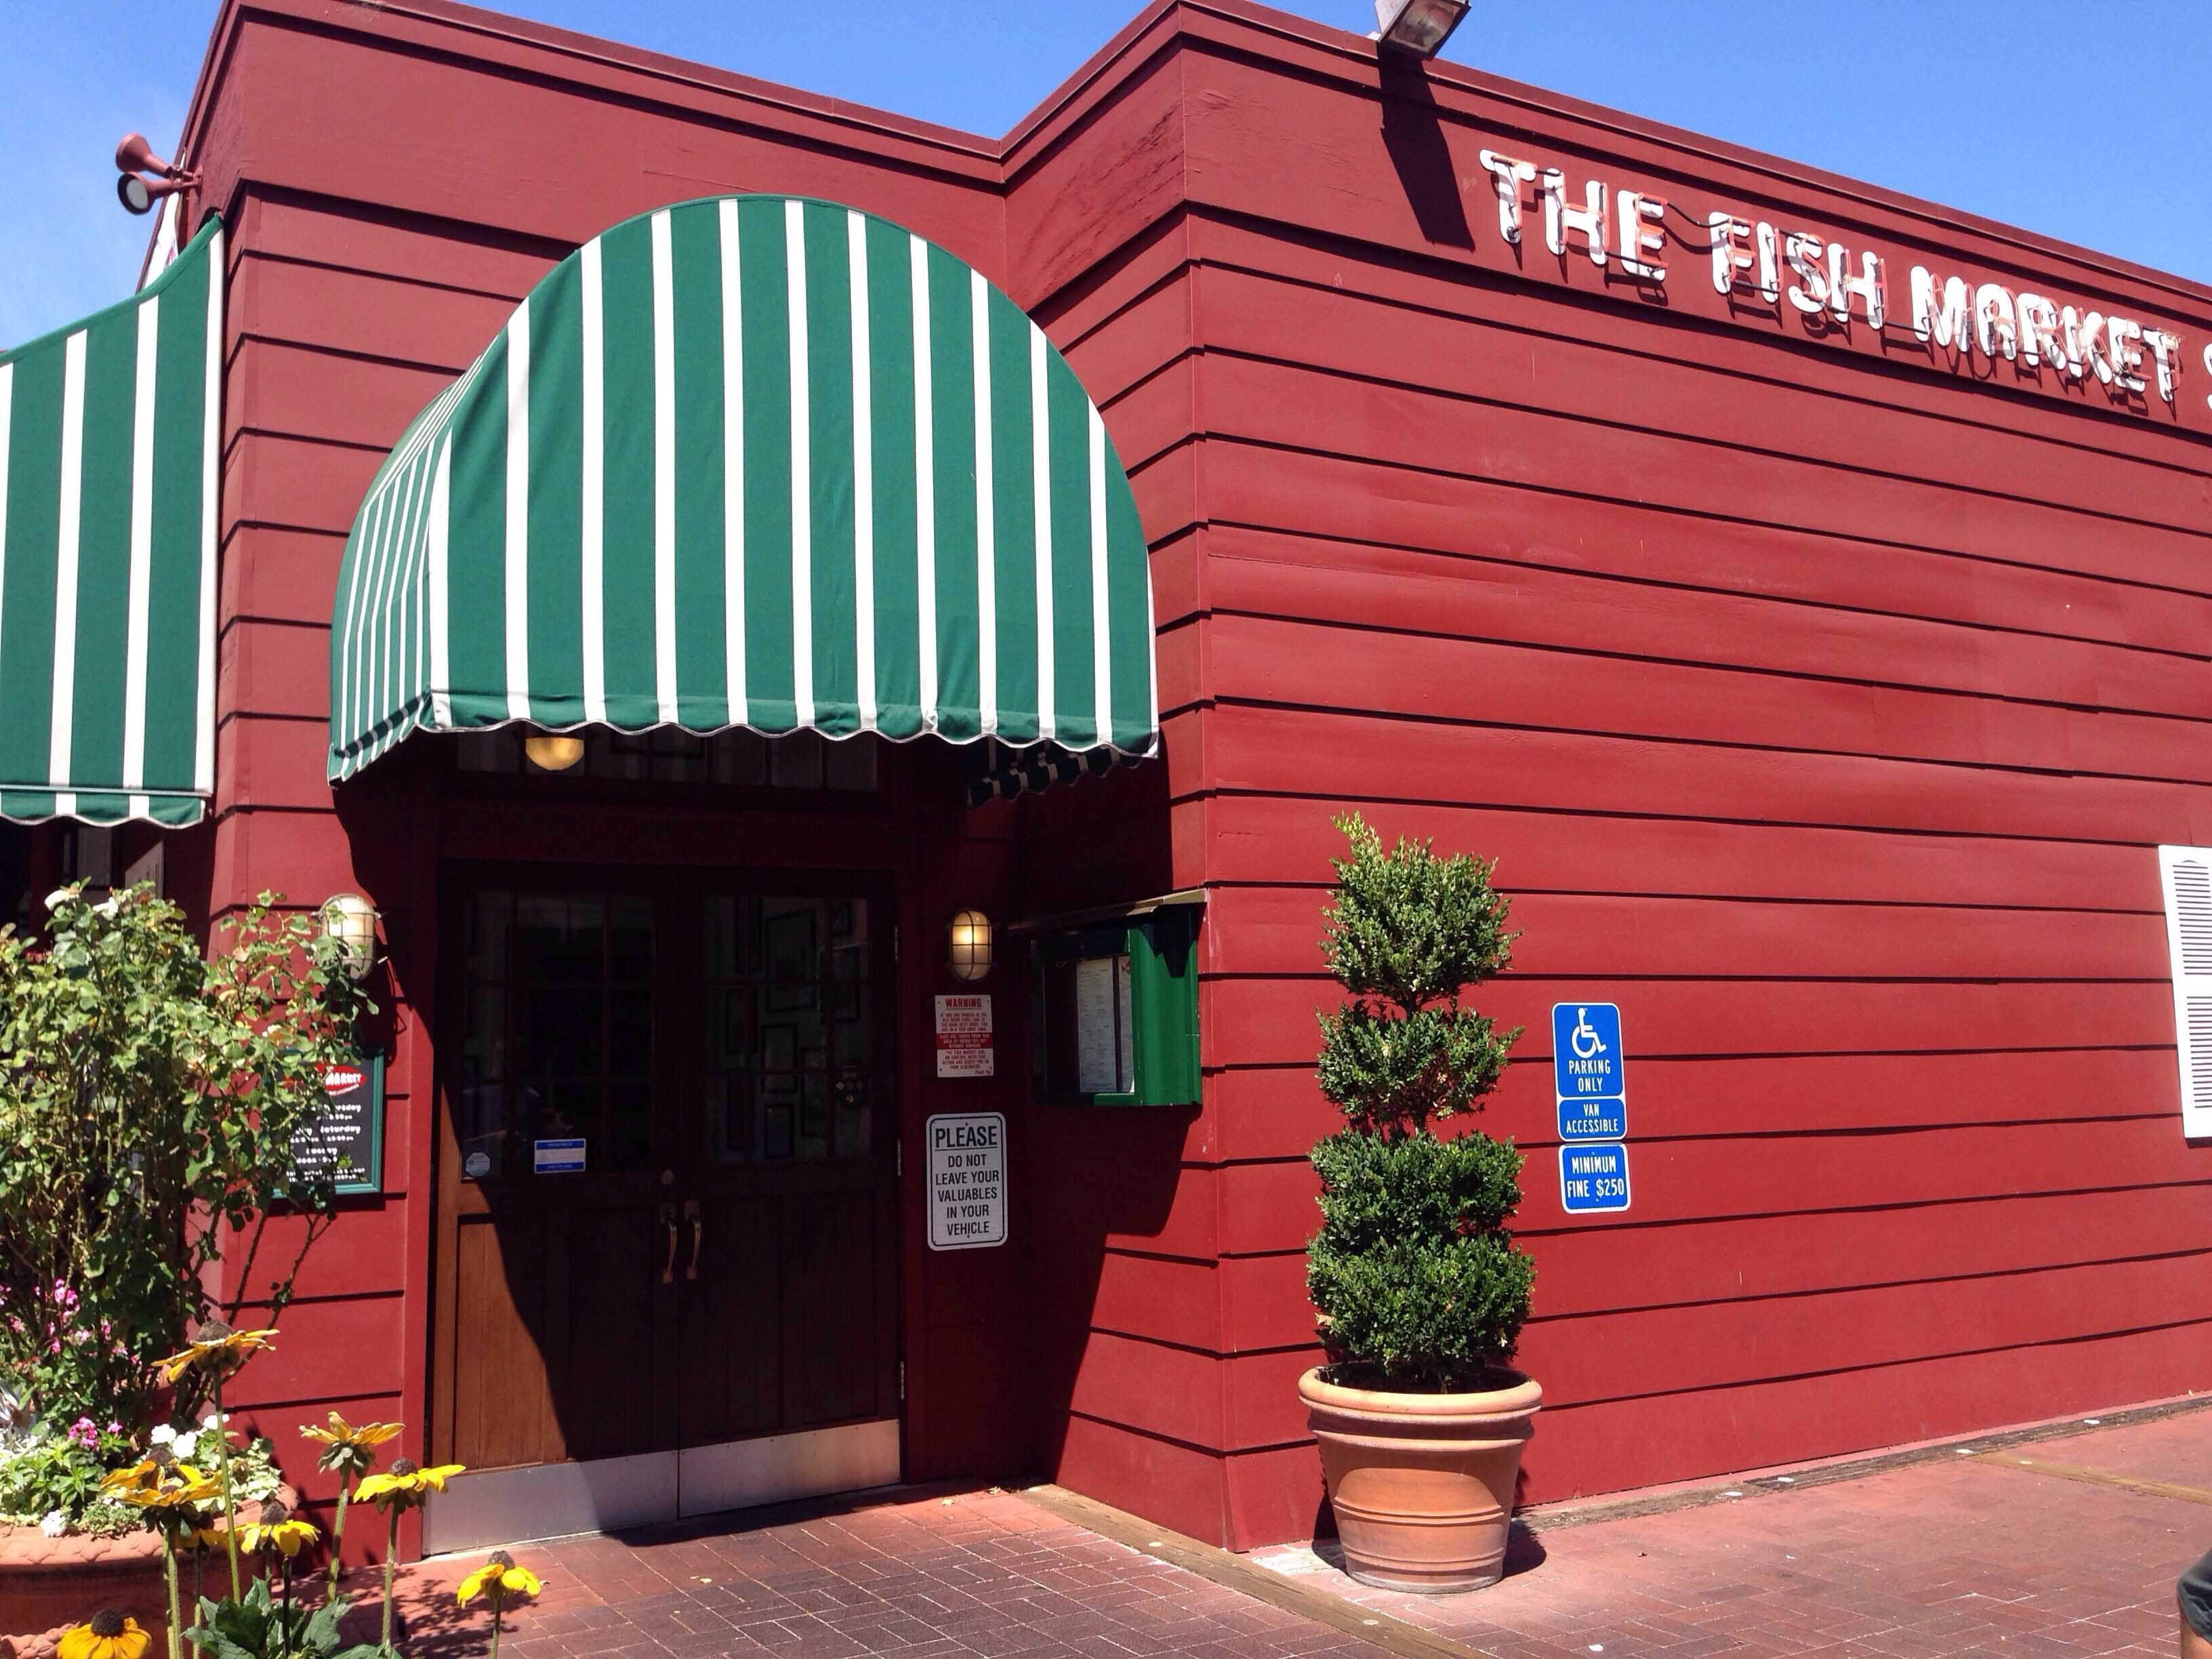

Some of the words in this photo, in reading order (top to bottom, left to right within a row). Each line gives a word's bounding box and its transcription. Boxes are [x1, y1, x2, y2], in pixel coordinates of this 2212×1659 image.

[1479, 149, 1668, 281] THE
[1708, 211, 1888, 330] FISH
[1910, 266, 2182, 402] MARKET
[945, 998, 982, 1008] WARNING
[1568, 1059, 1611, 1074] PARKING
[1578, 1078, 1603, 1092] ONLY
[1583, 1104, 1599, 1117] VAN
[1566, 1119, 1619, 1134] ACCESSIBLE
[935, 1126, 998, 1148] PLEASE
[949, 1155, 962, 1167] DO
[966, 1154, 987, 1166] NOT
[1572, 1155, 1616, 1174] MINIMUM
[935, 1172, 968, 1185] LEAVE
[971, 1170, 999, 1183] YOUR
[938, 1187, 997, 1202] VALUABLES
[1567, 1179, 1590, 1199] FINE
[1596, 1177, 1624, 1199] $250
[947, 1206, 957, 1218] IN
[961, 1204, 989, 1217] YOUR
[947, 1221, 989, 1235] VEHICLE
